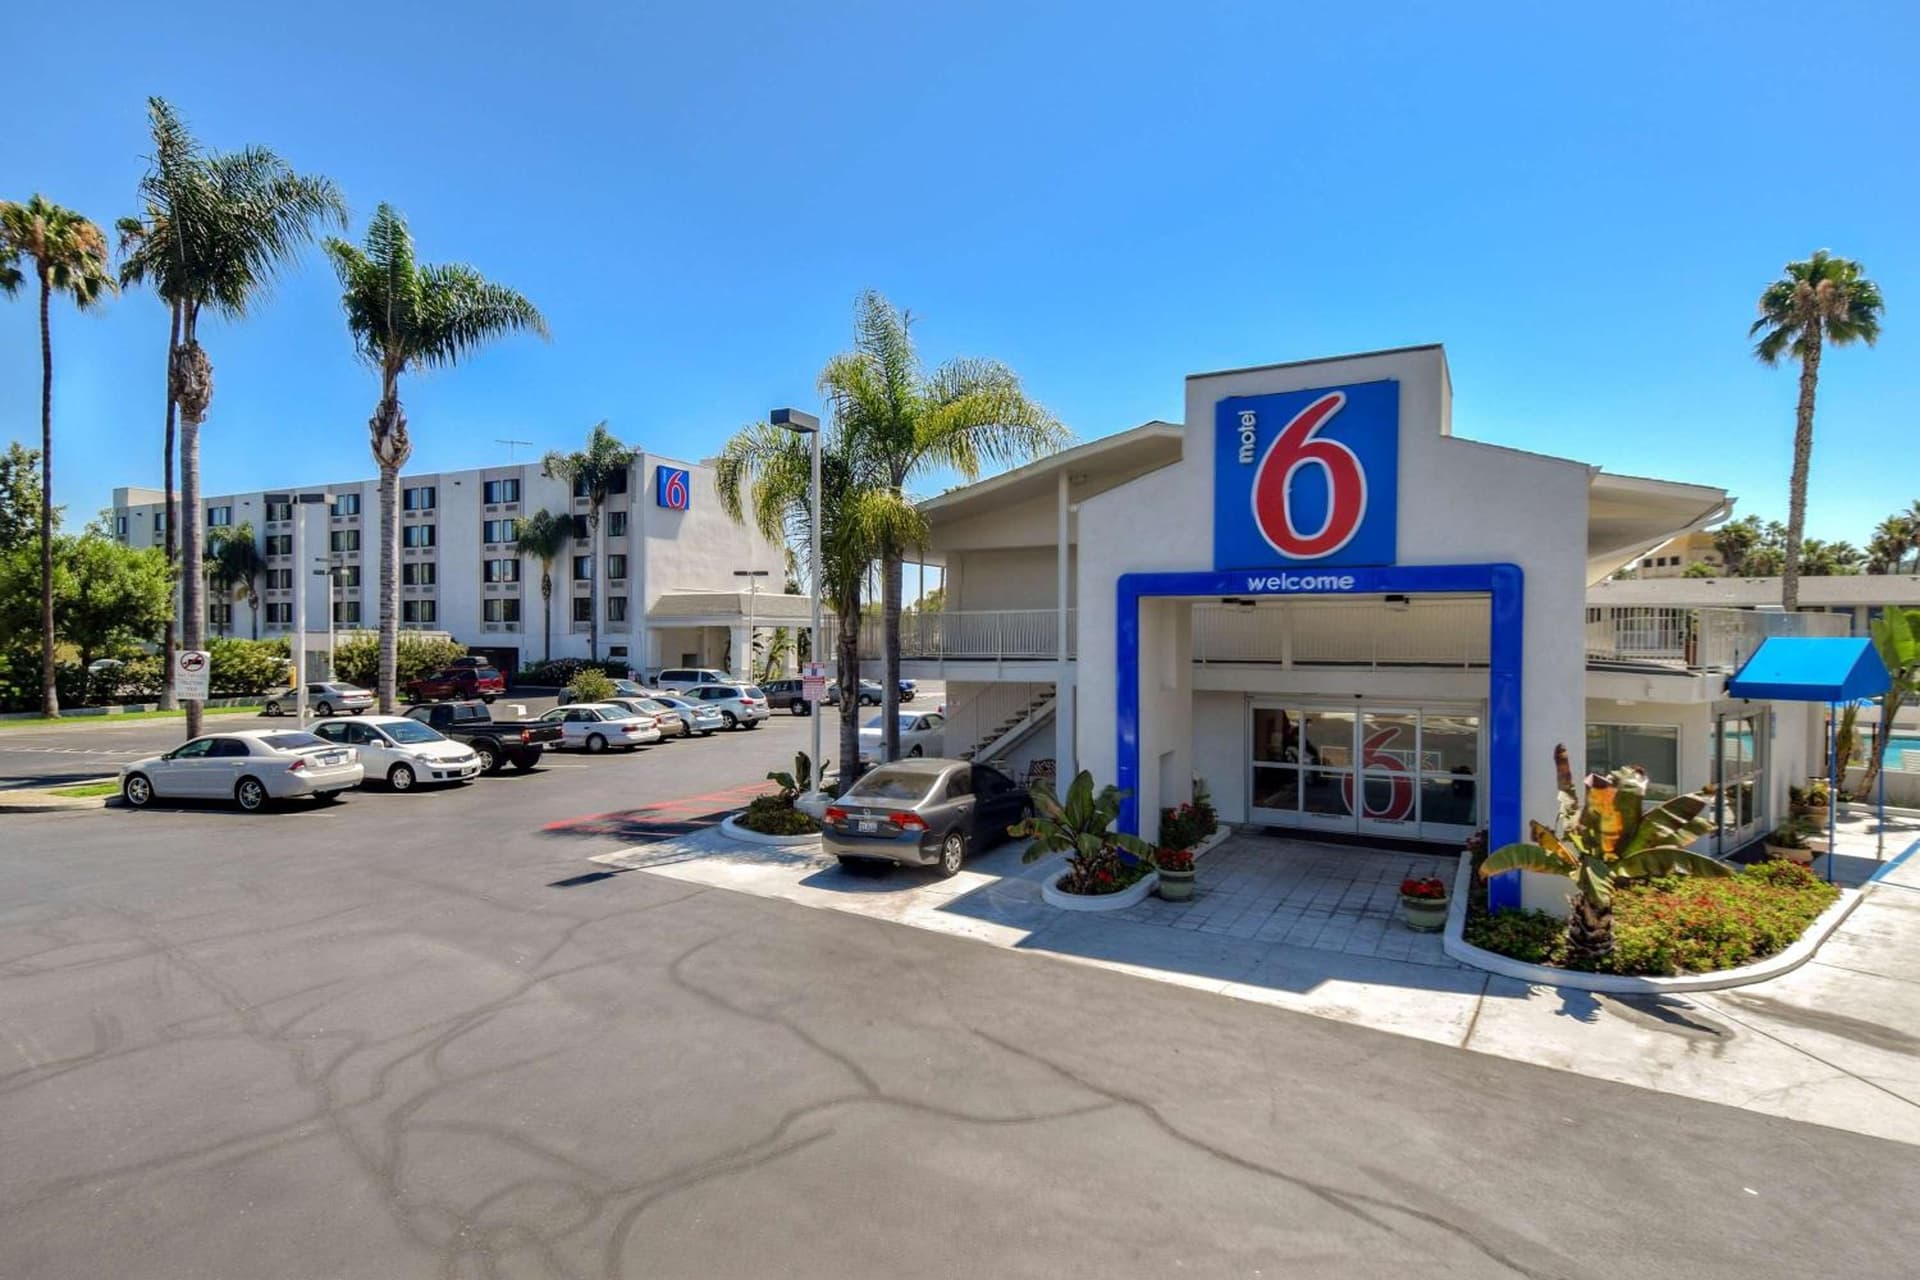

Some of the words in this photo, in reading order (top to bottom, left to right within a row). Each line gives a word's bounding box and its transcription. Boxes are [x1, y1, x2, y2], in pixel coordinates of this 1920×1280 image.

[665, 470, 687, 511] 6
[1237, 410, 1257, 464] motel
[1251, 391, 1368, 560] 6
[1248, 573, 1355, 591] welcome
[1341, 726, 1414, 823] 6
